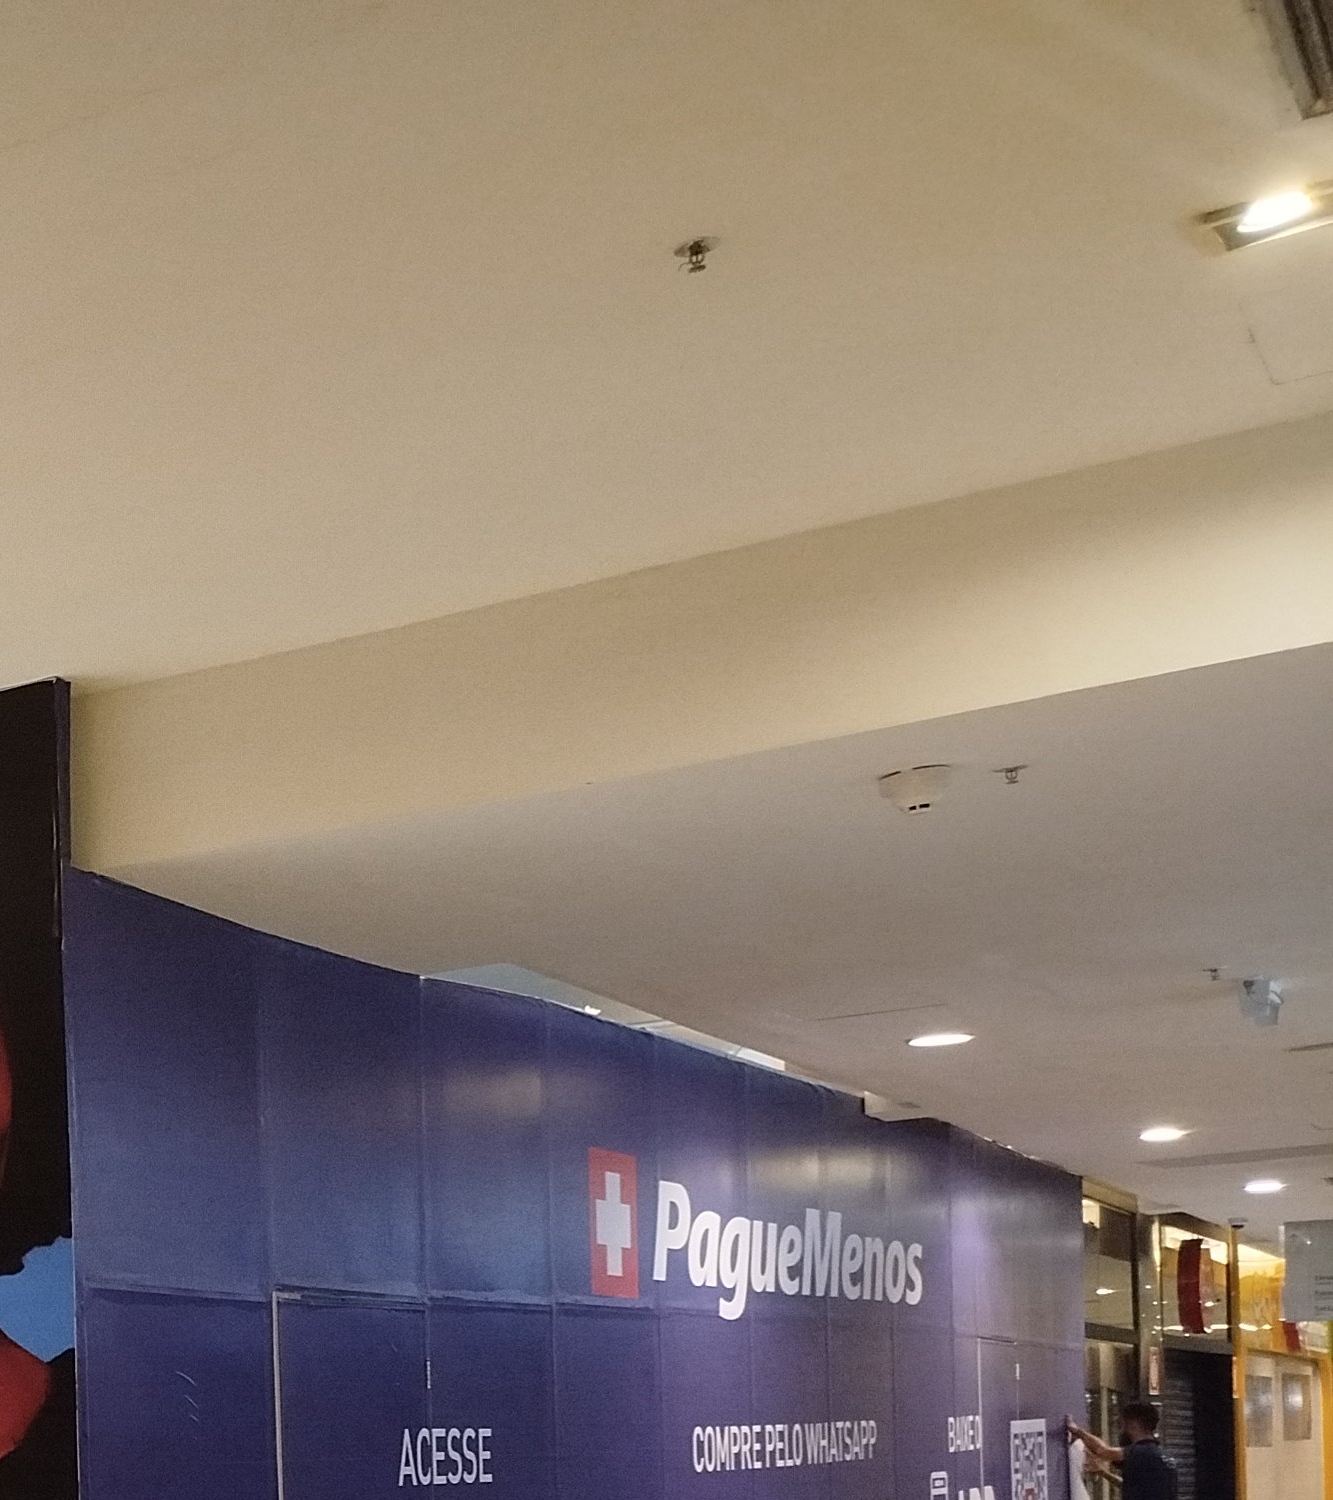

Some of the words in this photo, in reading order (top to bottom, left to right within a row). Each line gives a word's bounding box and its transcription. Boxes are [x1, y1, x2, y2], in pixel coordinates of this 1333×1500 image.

[653, 1180, 923, 1321] PagueMenos
[398, 1428, 493, 1487] ACESSE
[692, 1425, 763, 1473] COMPRE
[764, 1423, 803, 1468] PELO
[804, 1419, 878, 1464] WHATSAPP
